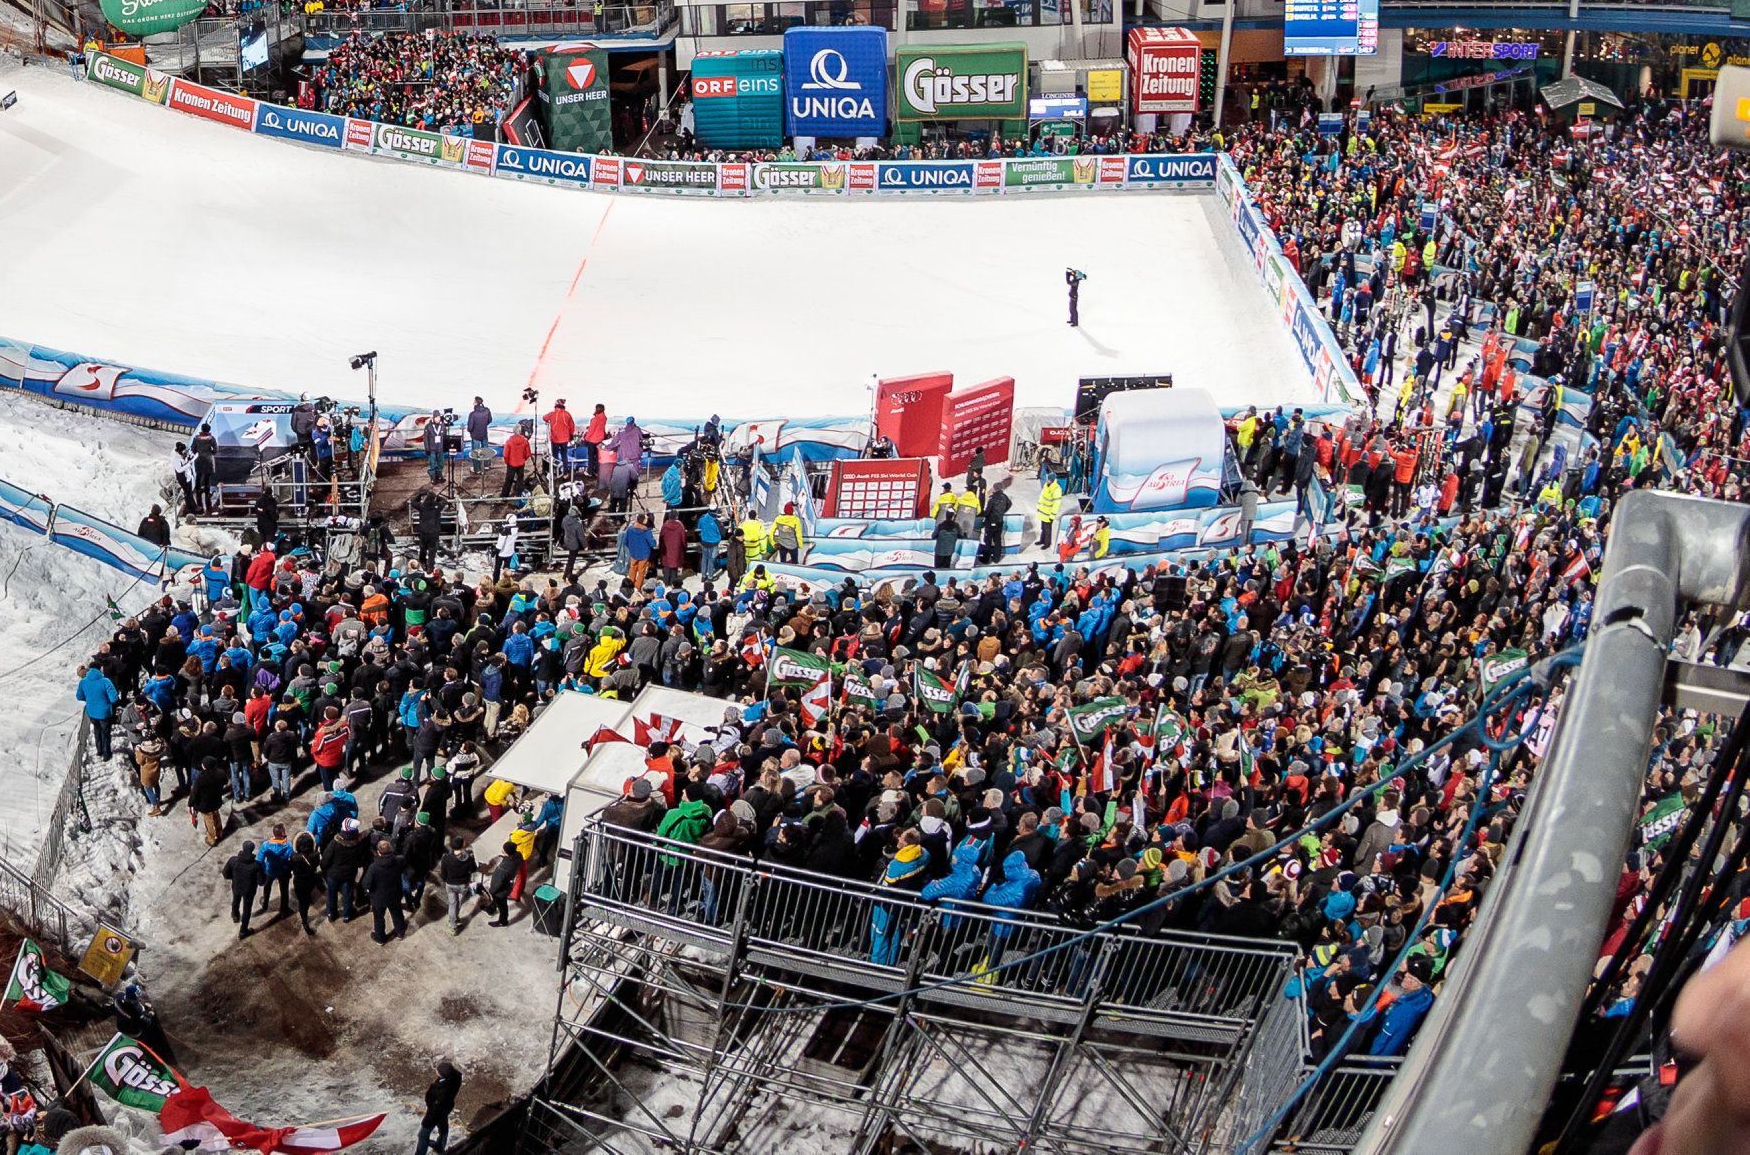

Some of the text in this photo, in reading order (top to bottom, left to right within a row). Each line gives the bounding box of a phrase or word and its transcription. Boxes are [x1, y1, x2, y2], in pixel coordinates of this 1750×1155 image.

[137, 15, 158, 23] GRÜNE
[1447, 41, 1540, 60] INTERSPORT
[1670, 44, 1700, 56] planet
[94, 53, 141, 87] Gösser
[1143, 53, 1195, 73] Kronen
[695, 78, 779, 94] ORF eins
[904, 57, 1018, 114] Gösser
[1142, 73, 1195, 96] Zeitung
[174, 87, 251, 124] Kronen Zeitung
[555, 93, 584, 106] UNSER
[585, 90, 608, 101] HEER
[793, 97, 876, 119] UNIQA
[286, 118, 339, 141] UNIQA
[377, 125, 438, 155] Gösser
[528, 155, 587, 179] UNIQA
[645, 169, 715, 183] UNSER HEER
[1011, 161, 1058, 173] Vernünftig
[1158, 160, 1213, 178] UNIQA
[754, 165, 816, 188] Gösser
[911, 169, 971, 185] UNIQA
[1022, 170, 1066, 183] genießen!
[261, 405, 291, 413] SPORT
[1146, 477, 1187, 491] AUSTRIA
